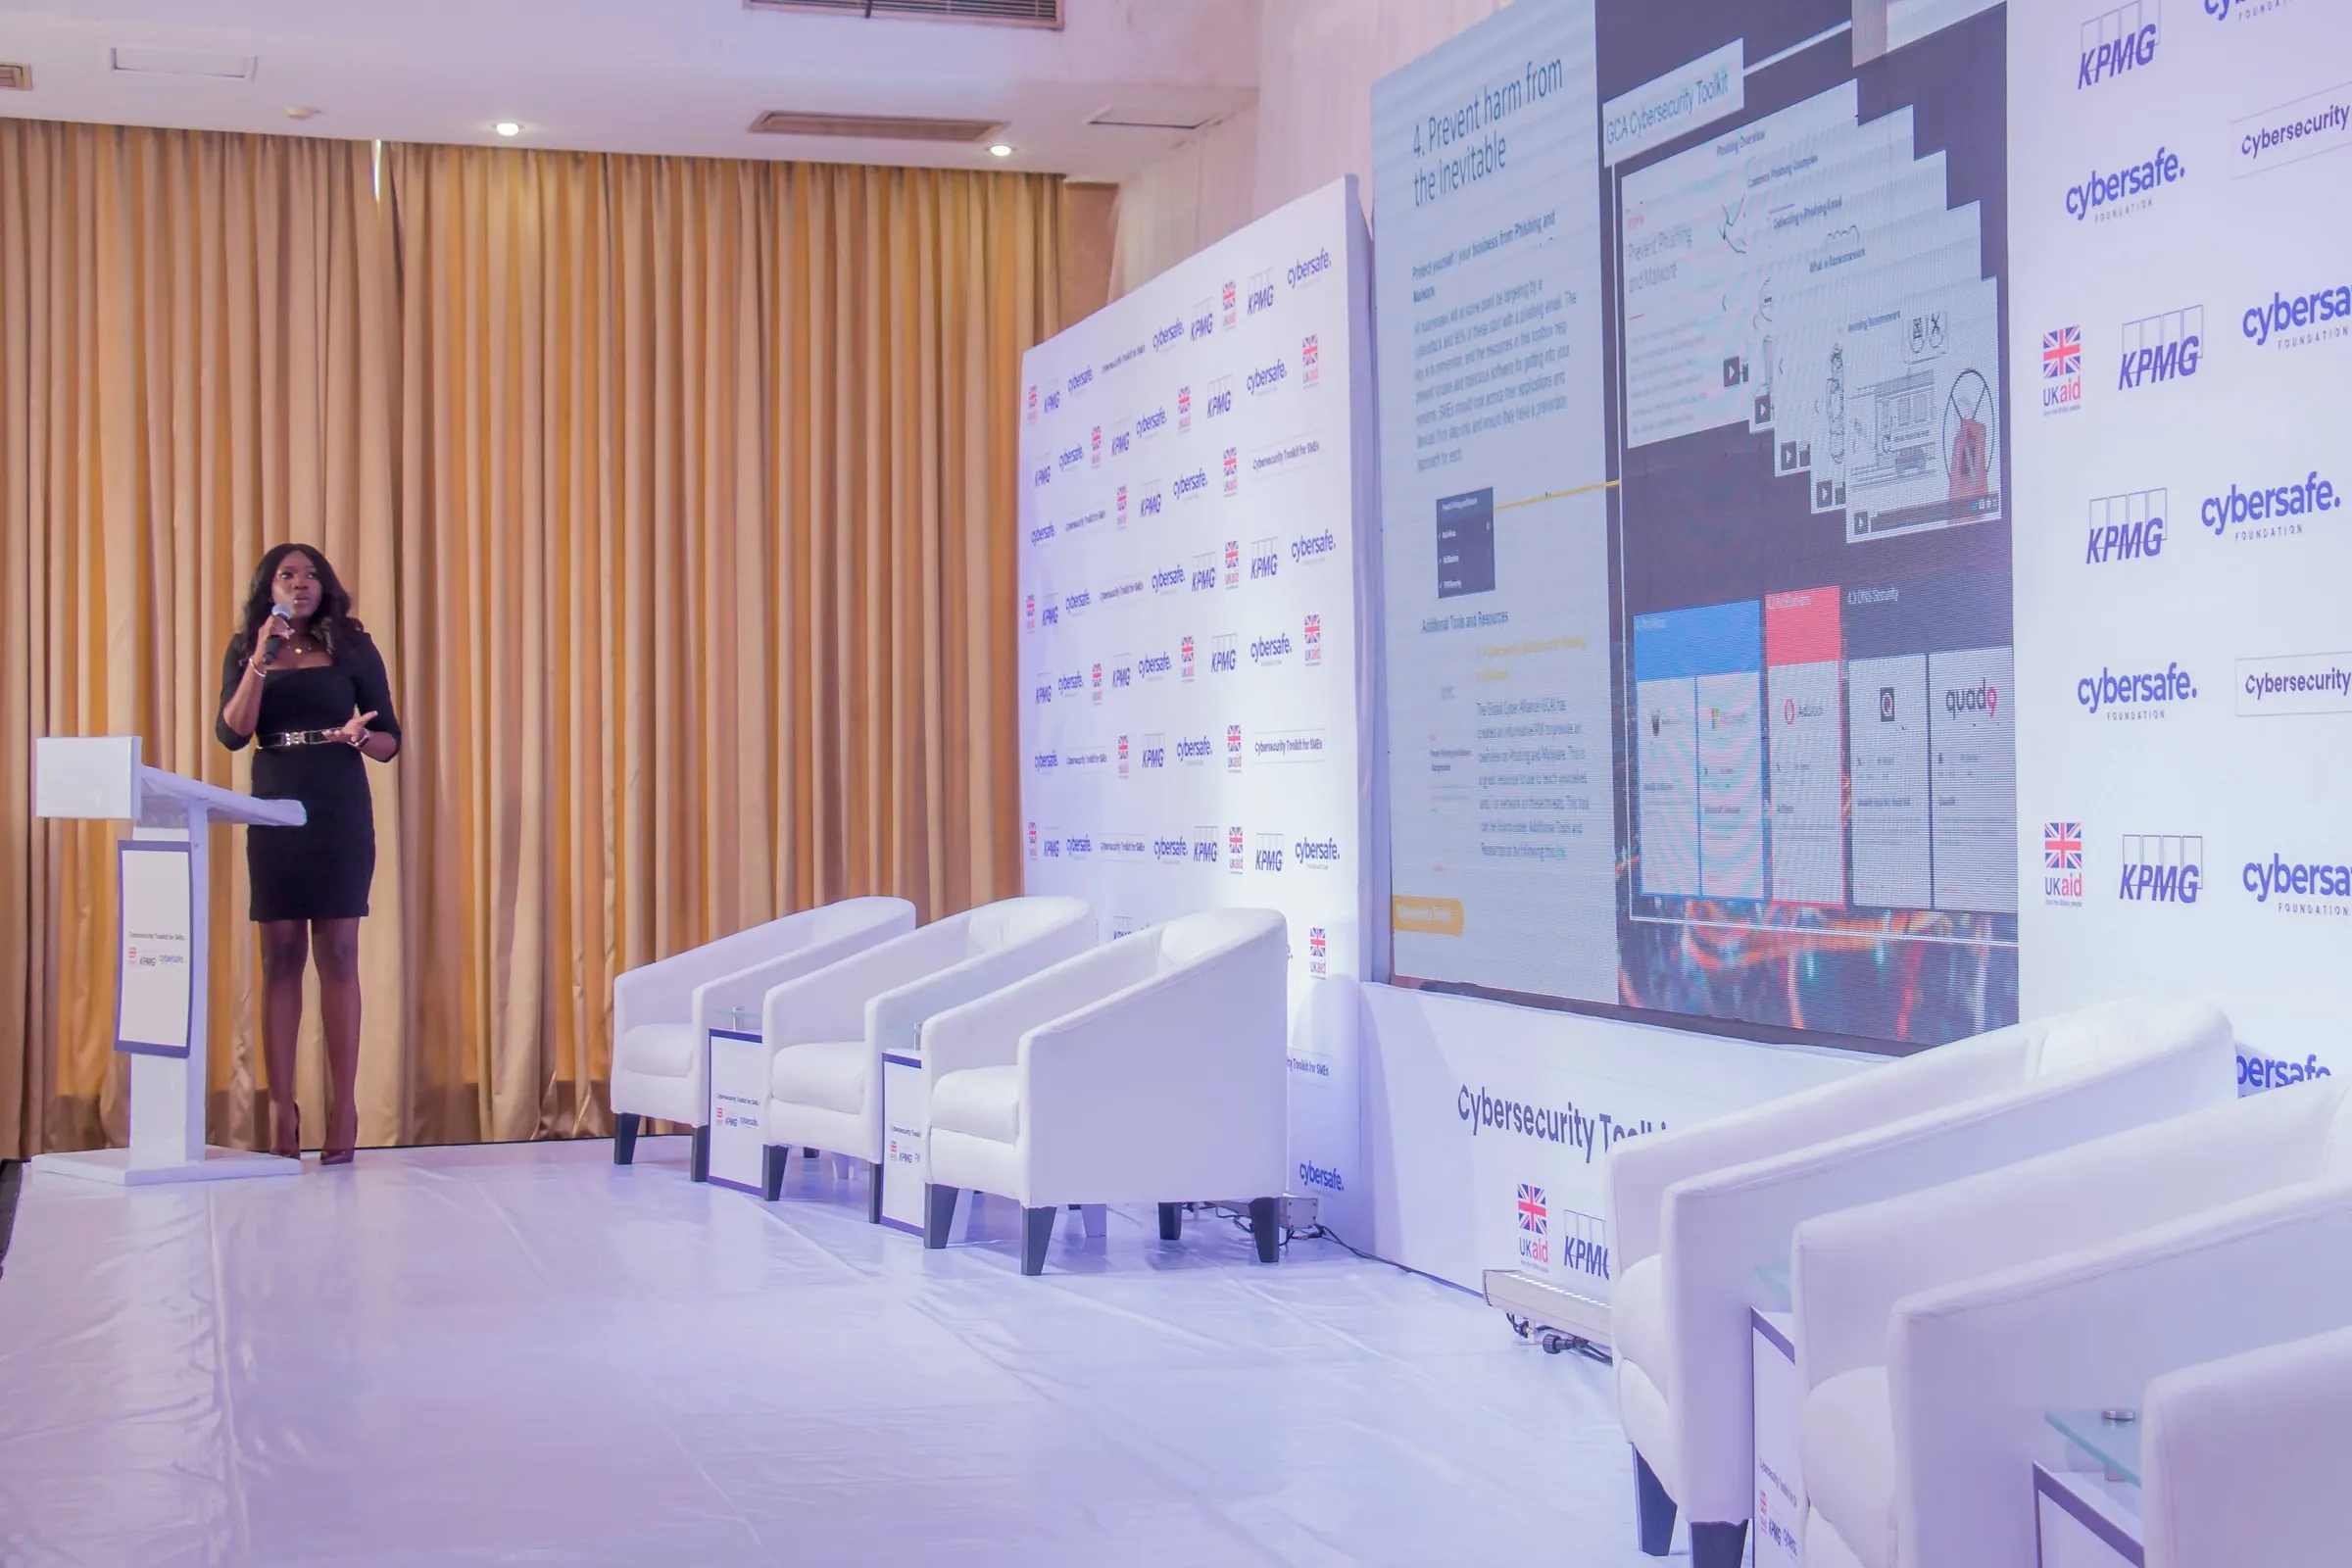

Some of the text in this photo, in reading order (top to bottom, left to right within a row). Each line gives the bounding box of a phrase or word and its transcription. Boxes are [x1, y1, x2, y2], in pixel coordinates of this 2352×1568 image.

[2078, 24, 2156, 90] KPMG
[1413, 57, 1563, 158] 4. Prevent harm from
[1606, 70, 1729, 145] GCA Cybersecurity Toolkit
[2241, 104, 2350, 160] Cybersecurity
[1413, 130, 1506, 208] the inevitable
[2066, 146, 2185, 220] cybersafe.
[2094, 199, 2153, 223] FOUNDATION
[1288, 247, 1332, 288] cybersafe.
[1248, 285, 1273, 317] KPMG
[2242, 285, 2352, 346] cybersa
[2278, 325, 2349, 351] FOUNDATION
[1247, 359, 1288, 394] cybersafe.
[2118, 335, 2199, 391] KPMG
[1207, 391, 1231, 418] KPMG
[2043, 375, 2082, 407] UKaid
[2201, 470, 2341, 536] cybersafe.
[1291, 528, 1336, 560] cybersafe.
[2085, 516, 2164, 564] KPMG
[2234, 523, 2303, 543] FOUNDATION
[1250, 553, 1278, 580] KPMG
[1211, 650, 1236, 672] KPMG
[1250, 633, 1293, 662] cybersafe.
[1945, 678, 1998, 718] quad9
[2077, 662, 2198, 714] cybersafe.
[2245, 666, 2352, 701] Cybersecurity
[2106, 709, 2166, 721] FOUNDATION
[1194, 842, 1218, 862] KPMG
[1255, 850, 1283, 872] KPMG
[1295, 837, 1341, 862] cybersafe.
[2044, 871, 2082, 898] UKaid
[2120, 863, 2199, 904] KPMG
[2242, 853, 2352, 903] cybersa
[2278, 903, 2349, 916] FOUNDATION
[1457, 1084, 1595, 1164] Cybersecurity
[1299, 1160, 1344, 1192] cybersafe.
[1519, 1237, 1548, 1263] UKaid
